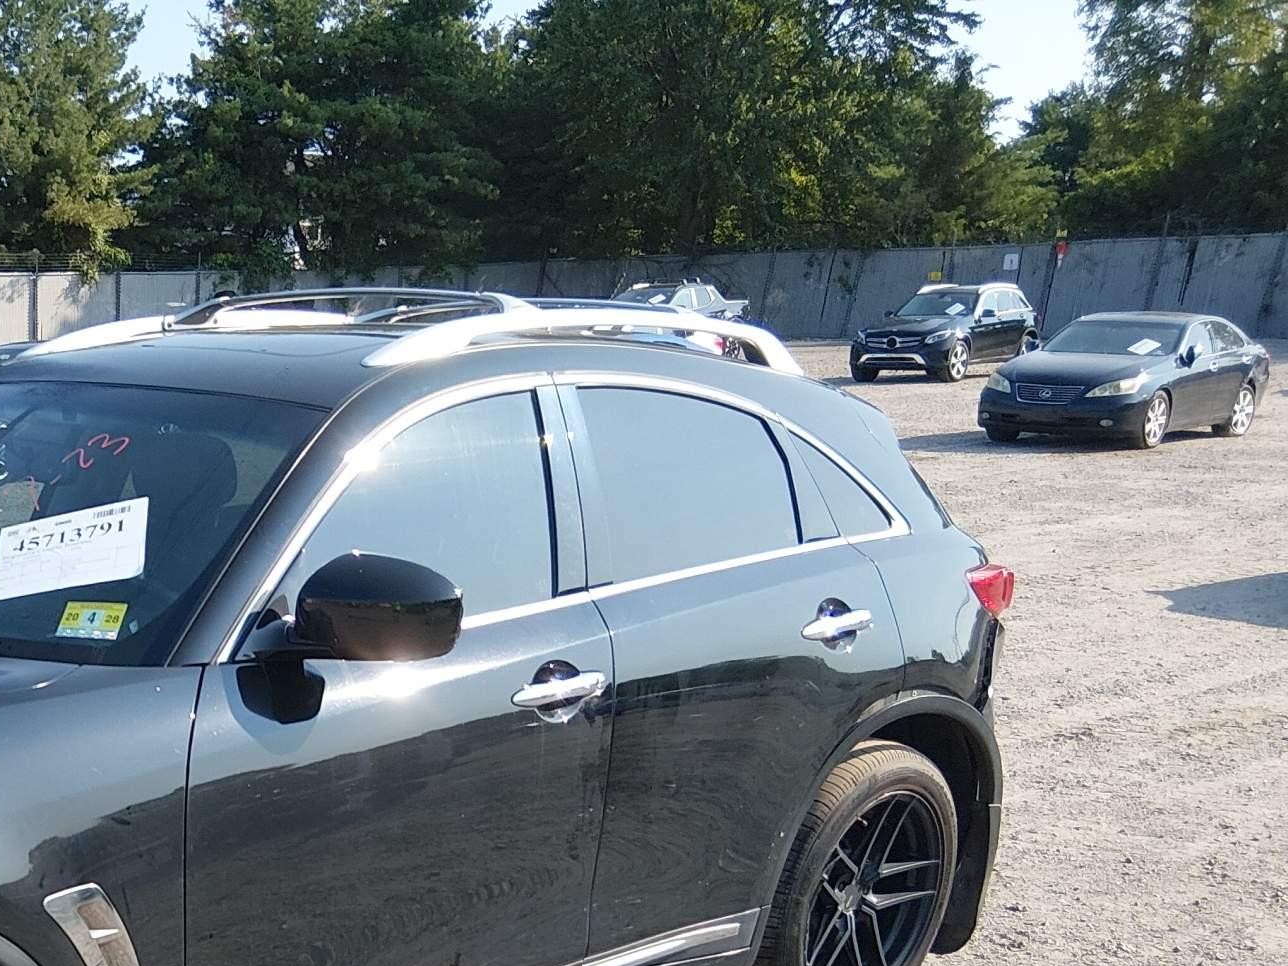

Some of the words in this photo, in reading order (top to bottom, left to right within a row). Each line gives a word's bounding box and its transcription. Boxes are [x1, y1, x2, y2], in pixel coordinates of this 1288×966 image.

[13, 520, 124, 552] 45713791
[65, 612, 80, 622] 20
[87, 611, 97, 625] 4
